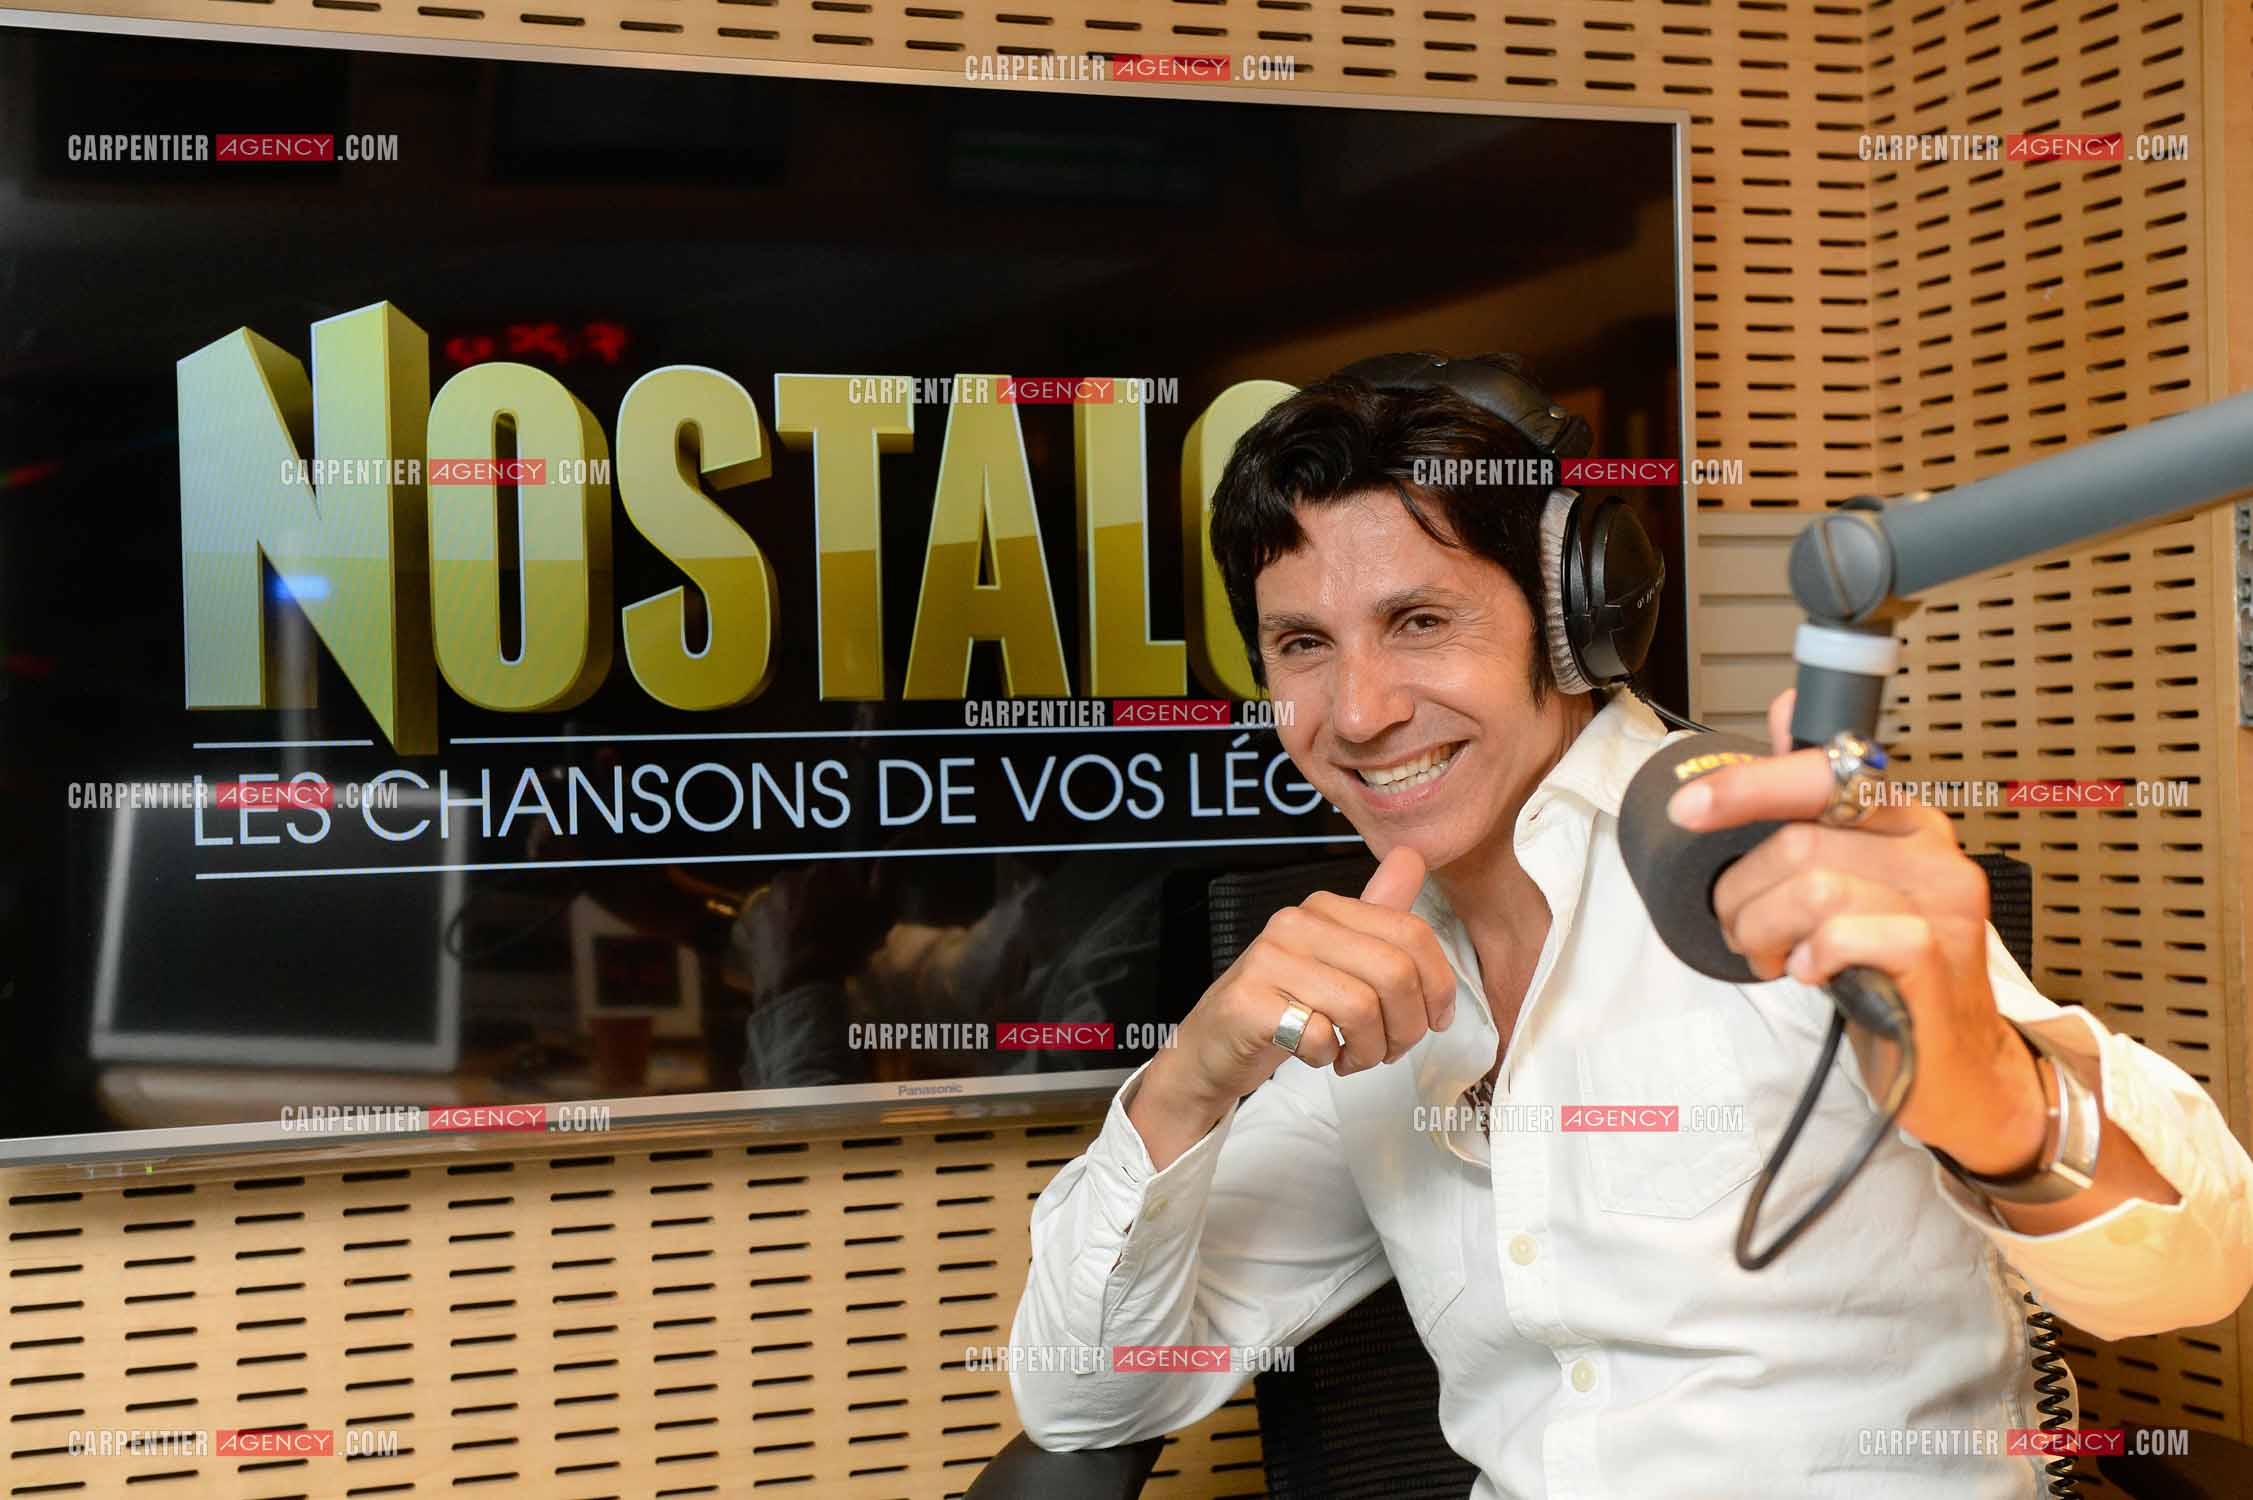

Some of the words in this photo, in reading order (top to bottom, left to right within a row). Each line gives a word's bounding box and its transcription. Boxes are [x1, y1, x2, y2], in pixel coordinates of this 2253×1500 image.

[194, 772, 331, 846] LES
[362, 759, 851, 842] CHANSONS
[879, 758, 976, 826] DE
[1001, 752, 1165, 821] VOS
[1190, 733, 1342, 817] LÉG
[898, 1084, 963, 1097] Panasonic
